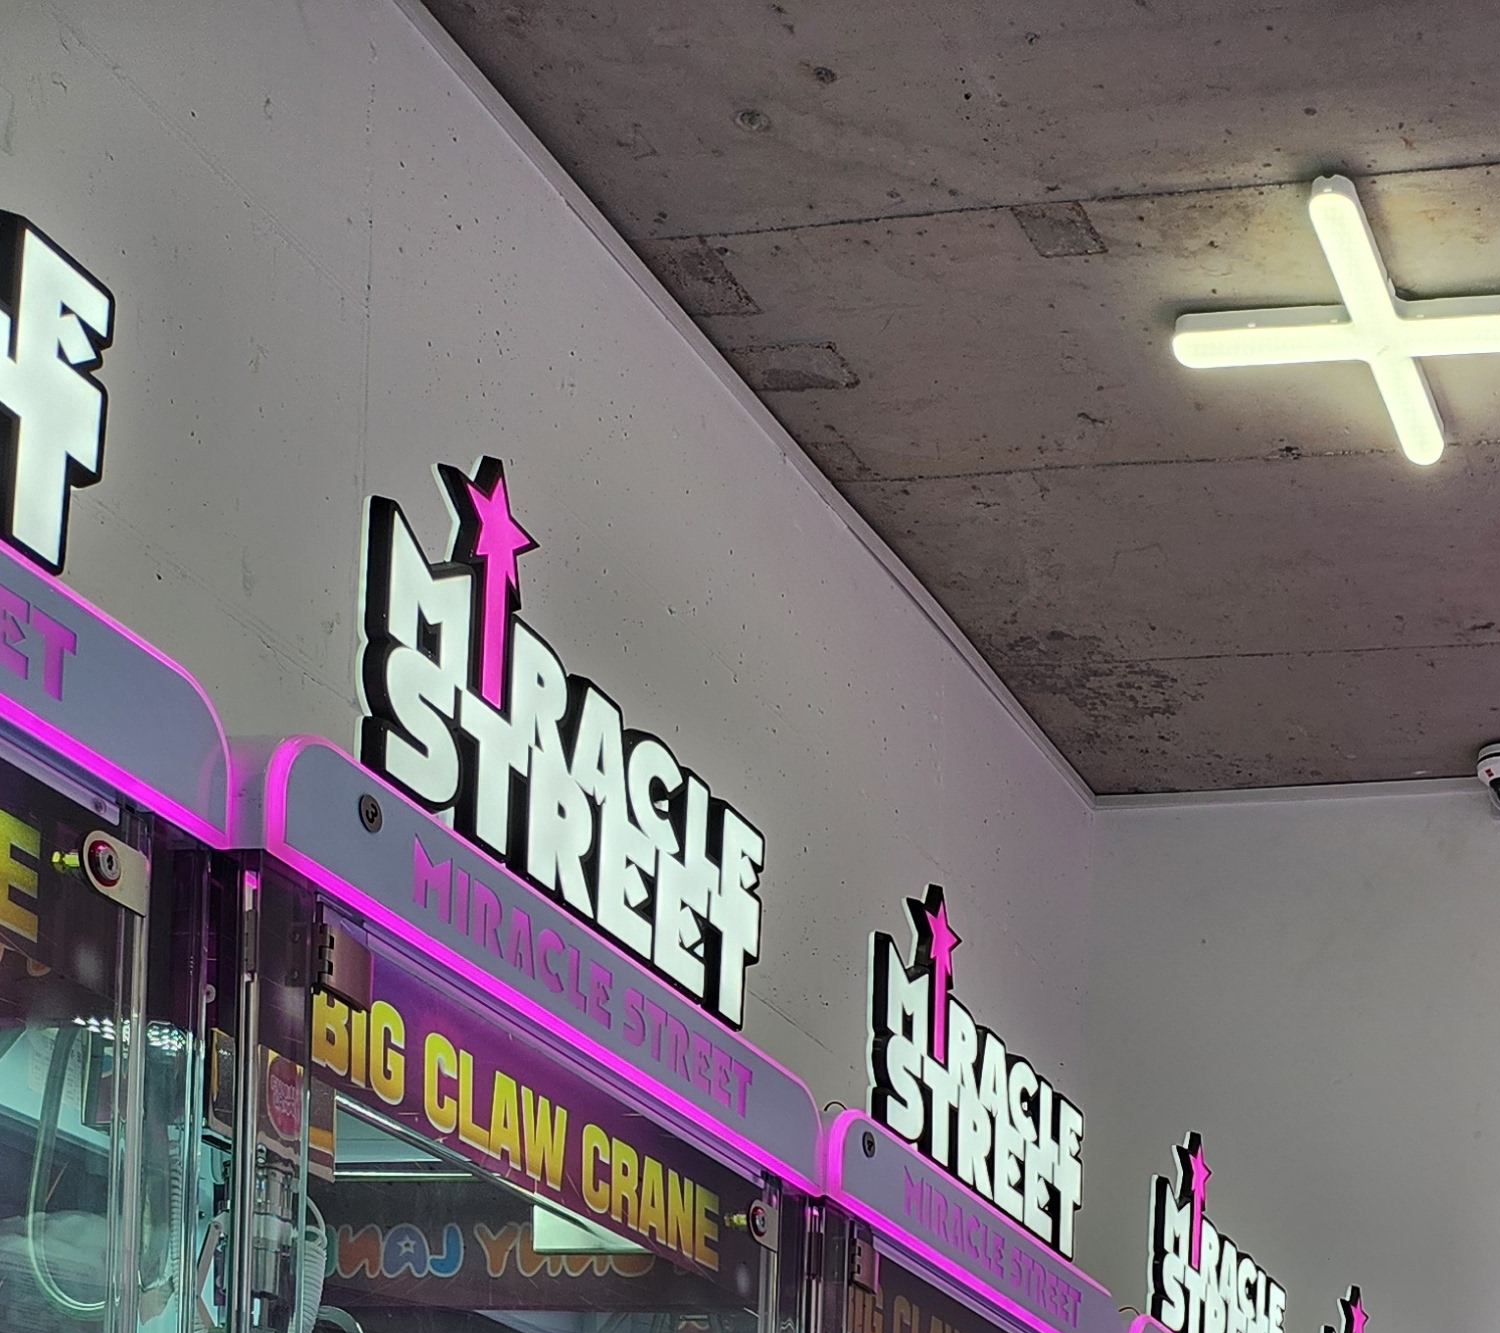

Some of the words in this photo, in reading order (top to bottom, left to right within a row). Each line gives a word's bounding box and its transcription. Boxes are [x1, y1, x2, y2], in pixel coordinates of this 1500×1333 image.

[386, 478, 763, 892] MIRACLE
[384, 646, 760, 1026] STREET
[412, 833, 612, 1030] MIRACLE
[622, 993, 754, 1119] STREET
[885, 903, 1084, 1155] MIRACLE
[424, 1031, 569, 1193] CLAW
[581, 1124, 720, 1271] CRANE
[884, 1034, 1082, 1258] STREET
[903, 1165, 1005, 1279] MIRACLE
[1009, 1246, 1082, 1329] STREET
[1161, 1148, 1286, 1333] MIRACLE
